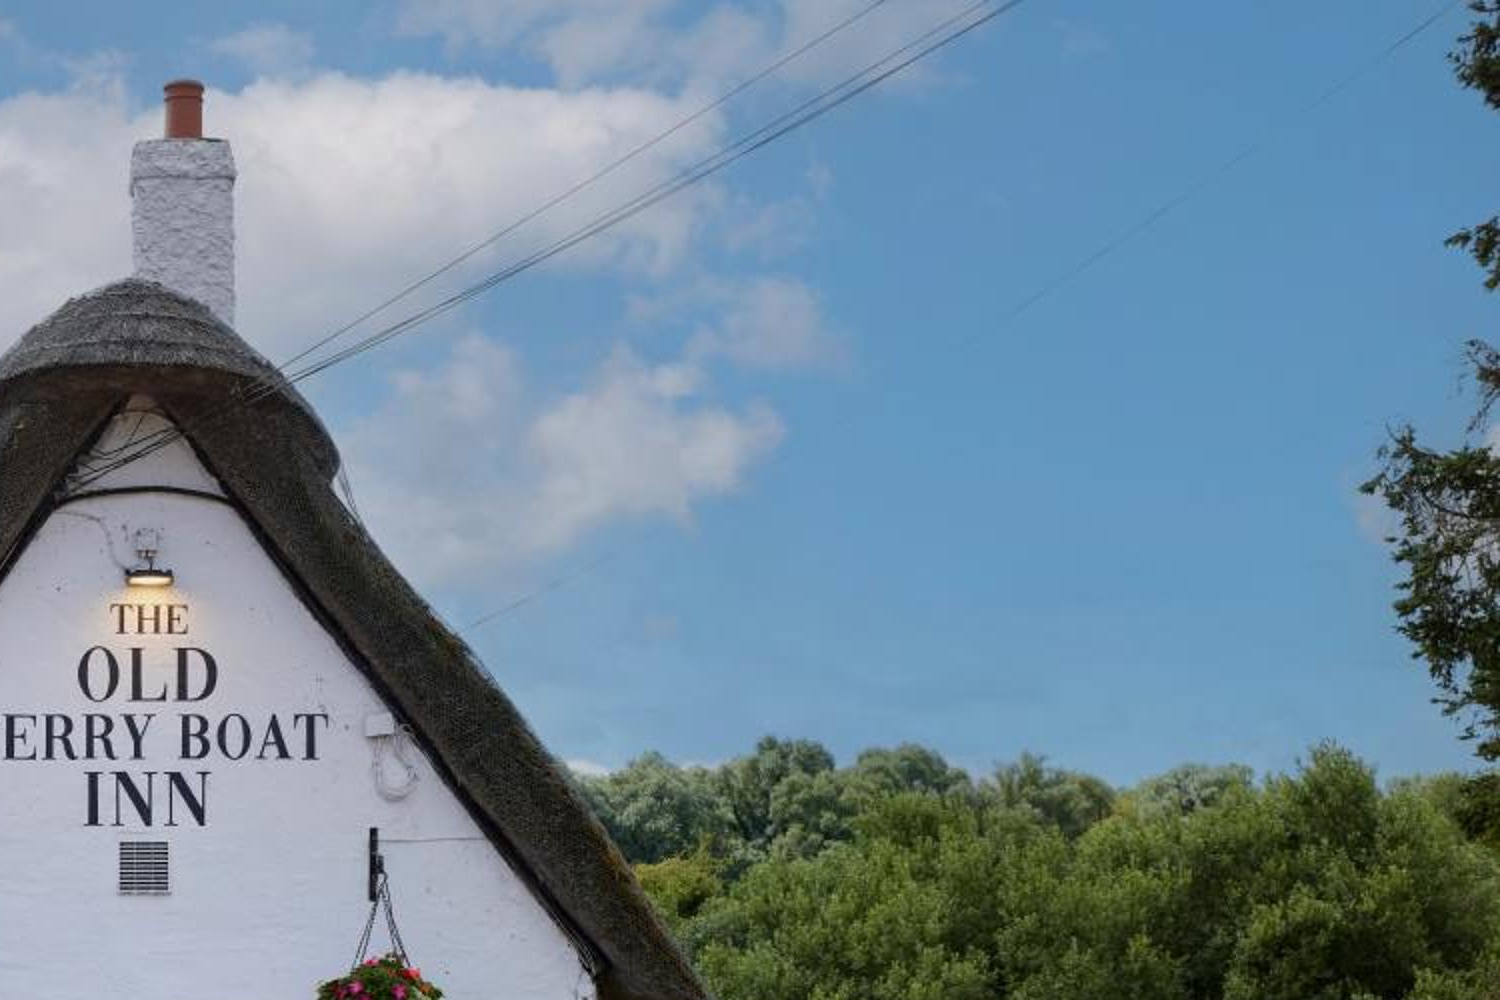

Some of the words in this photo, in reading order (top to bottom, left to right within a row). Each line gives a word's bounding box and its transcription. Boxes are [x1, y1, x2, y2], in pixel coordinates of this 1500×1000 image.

[109, 603, 189, 635] THE
[77, 645, 218, 703] OLD
[179, 713, 329, 761] BOAT
[83, 770, 211, 827] INN
